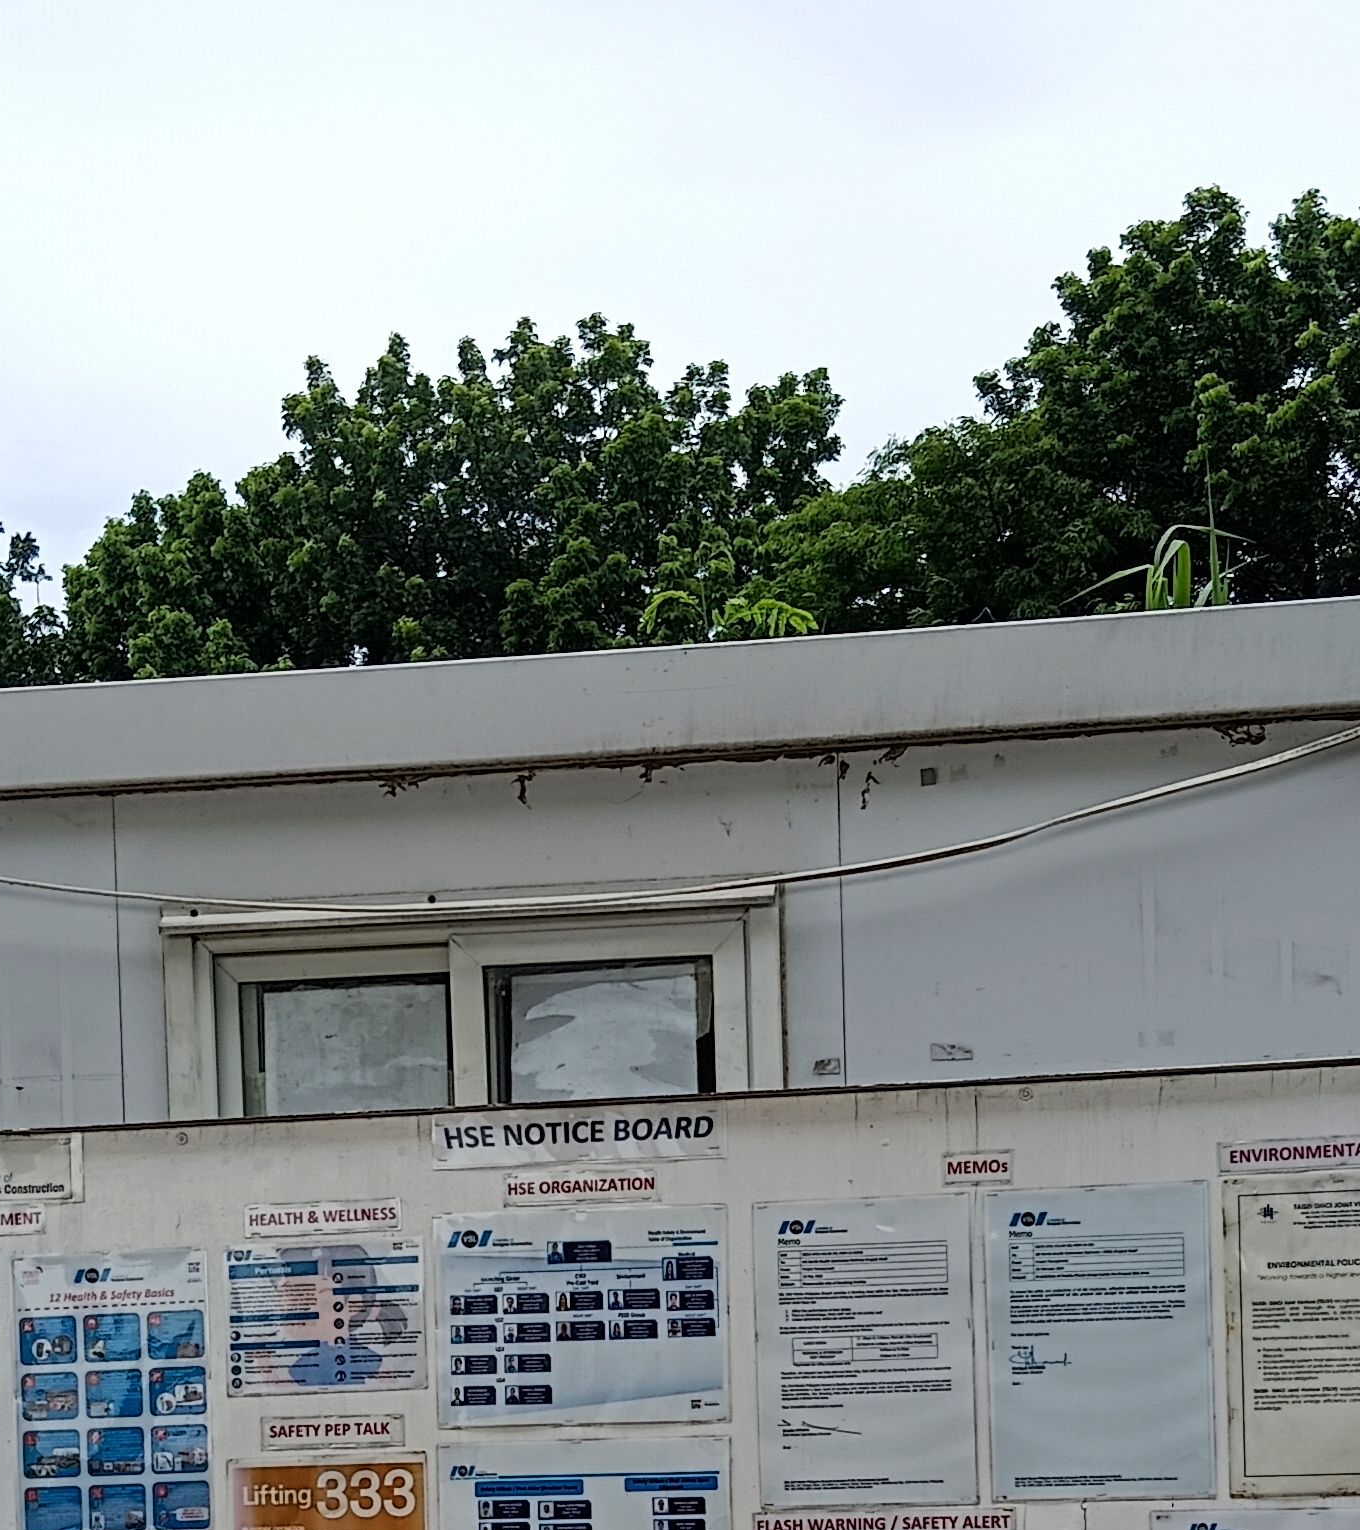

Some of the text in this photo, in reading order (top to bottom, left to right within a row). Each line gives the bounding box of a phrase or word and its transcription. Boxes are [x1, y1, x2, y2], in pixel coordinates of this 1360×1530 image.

[444, 1115, 714, 1149] HSE NOTICE BOARD
[947, 1159, 1009, 1175] MEMOs
[3, 1173, 13, 1183] of
[507, 1177, 655, 1195] HSE ORGANIZATION
[4, 1183, 65, 1195] Construction
[249, 1207, 397, 1226] HEALTH & WELLNESS
[50, 1288, 175, 1303] 12 Health & Safety Basics
[269, 1421, 390, 1438] SAFETY PEP TALK
[243, 1468, 416, 1519] Lifting 333
[902, 1515, 958, 1530] SAFETY
[962, 1515, 1011, 1529] ALERT
